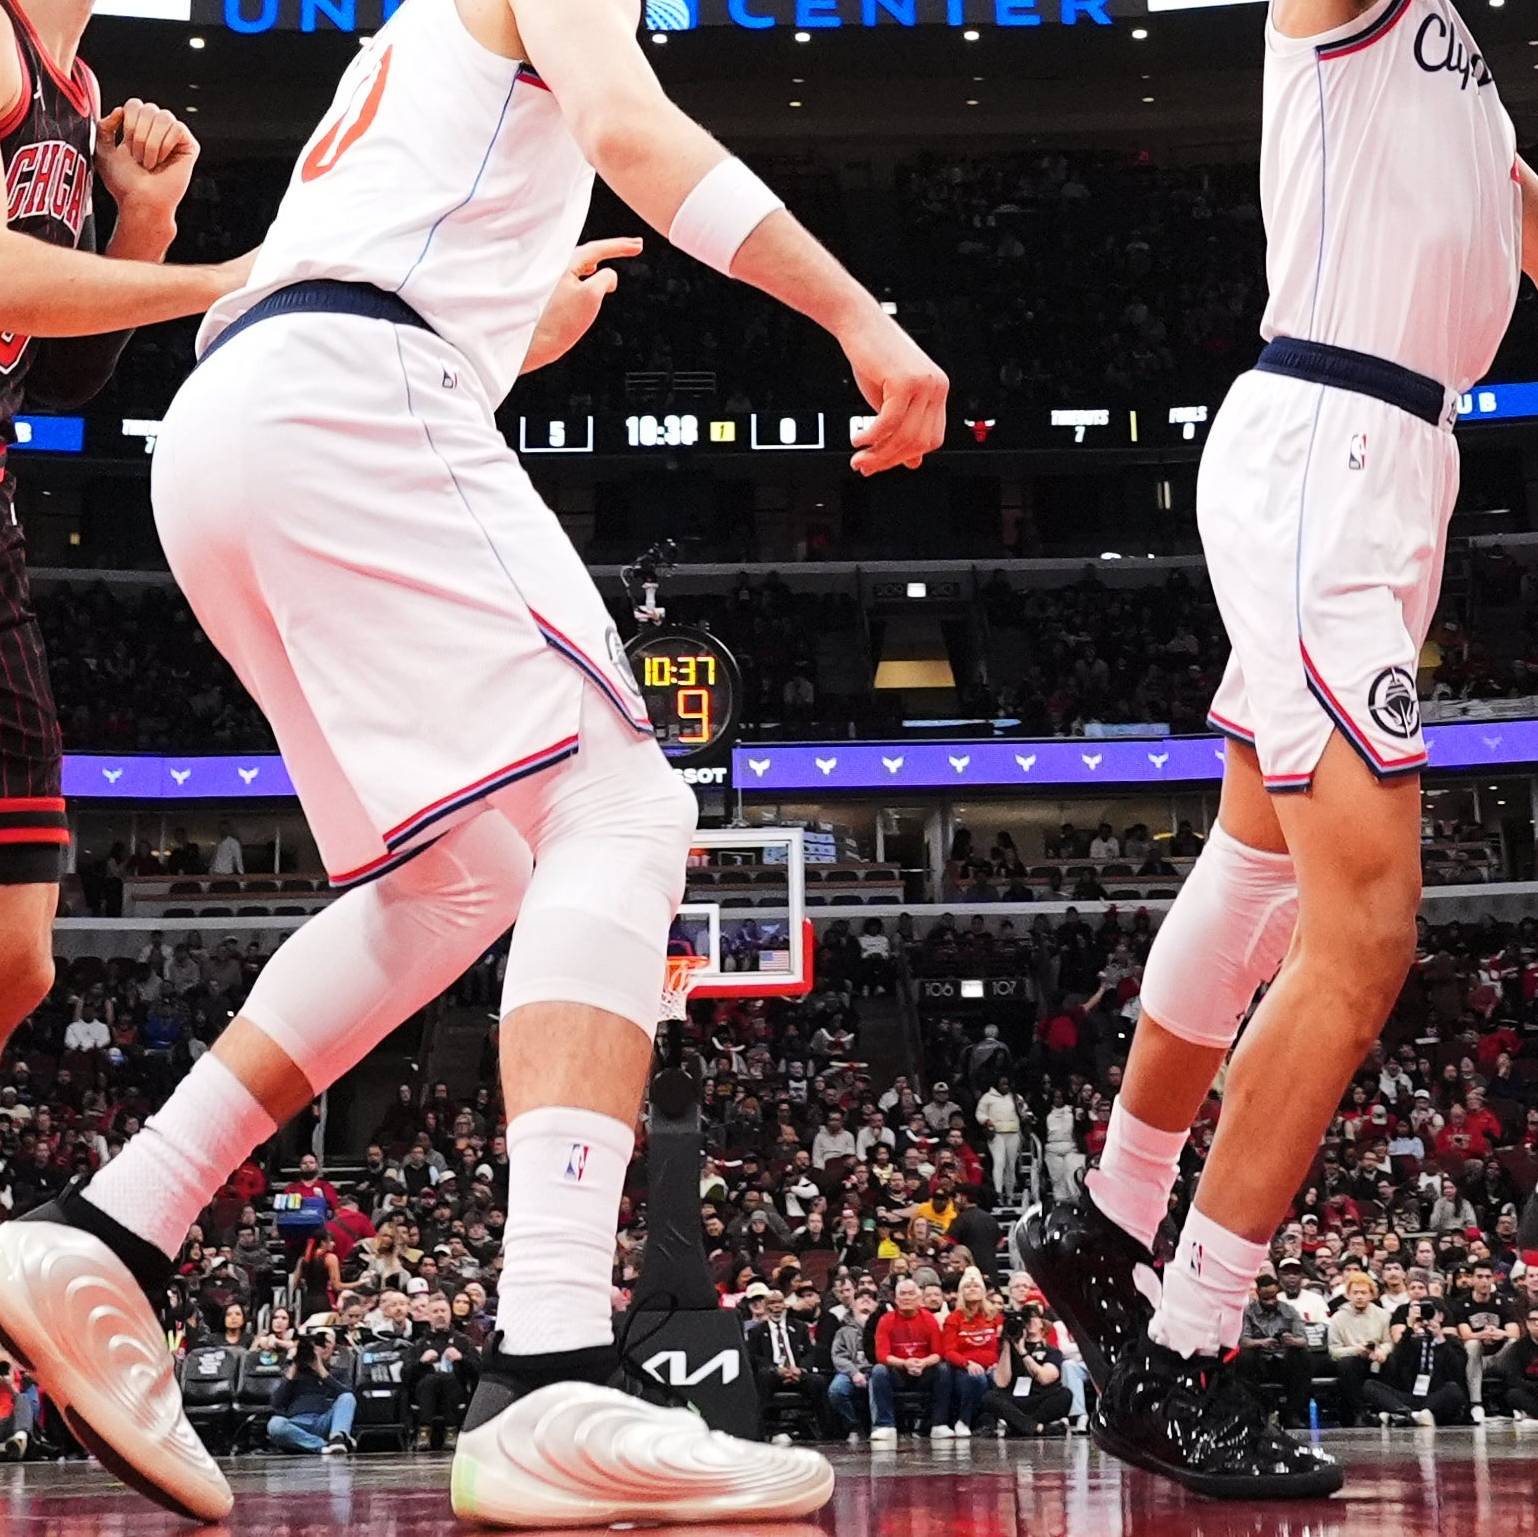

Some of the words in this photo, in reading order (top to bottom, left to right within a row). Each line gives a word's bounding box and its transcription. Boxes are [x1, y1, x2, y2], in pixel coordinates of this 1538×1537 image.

[549, 421, 565, 447] 5
[1075, 426, 1085, 443] 7
[644, 656, 715, 686] 10:37
[677, 689, 711, 742] 9
